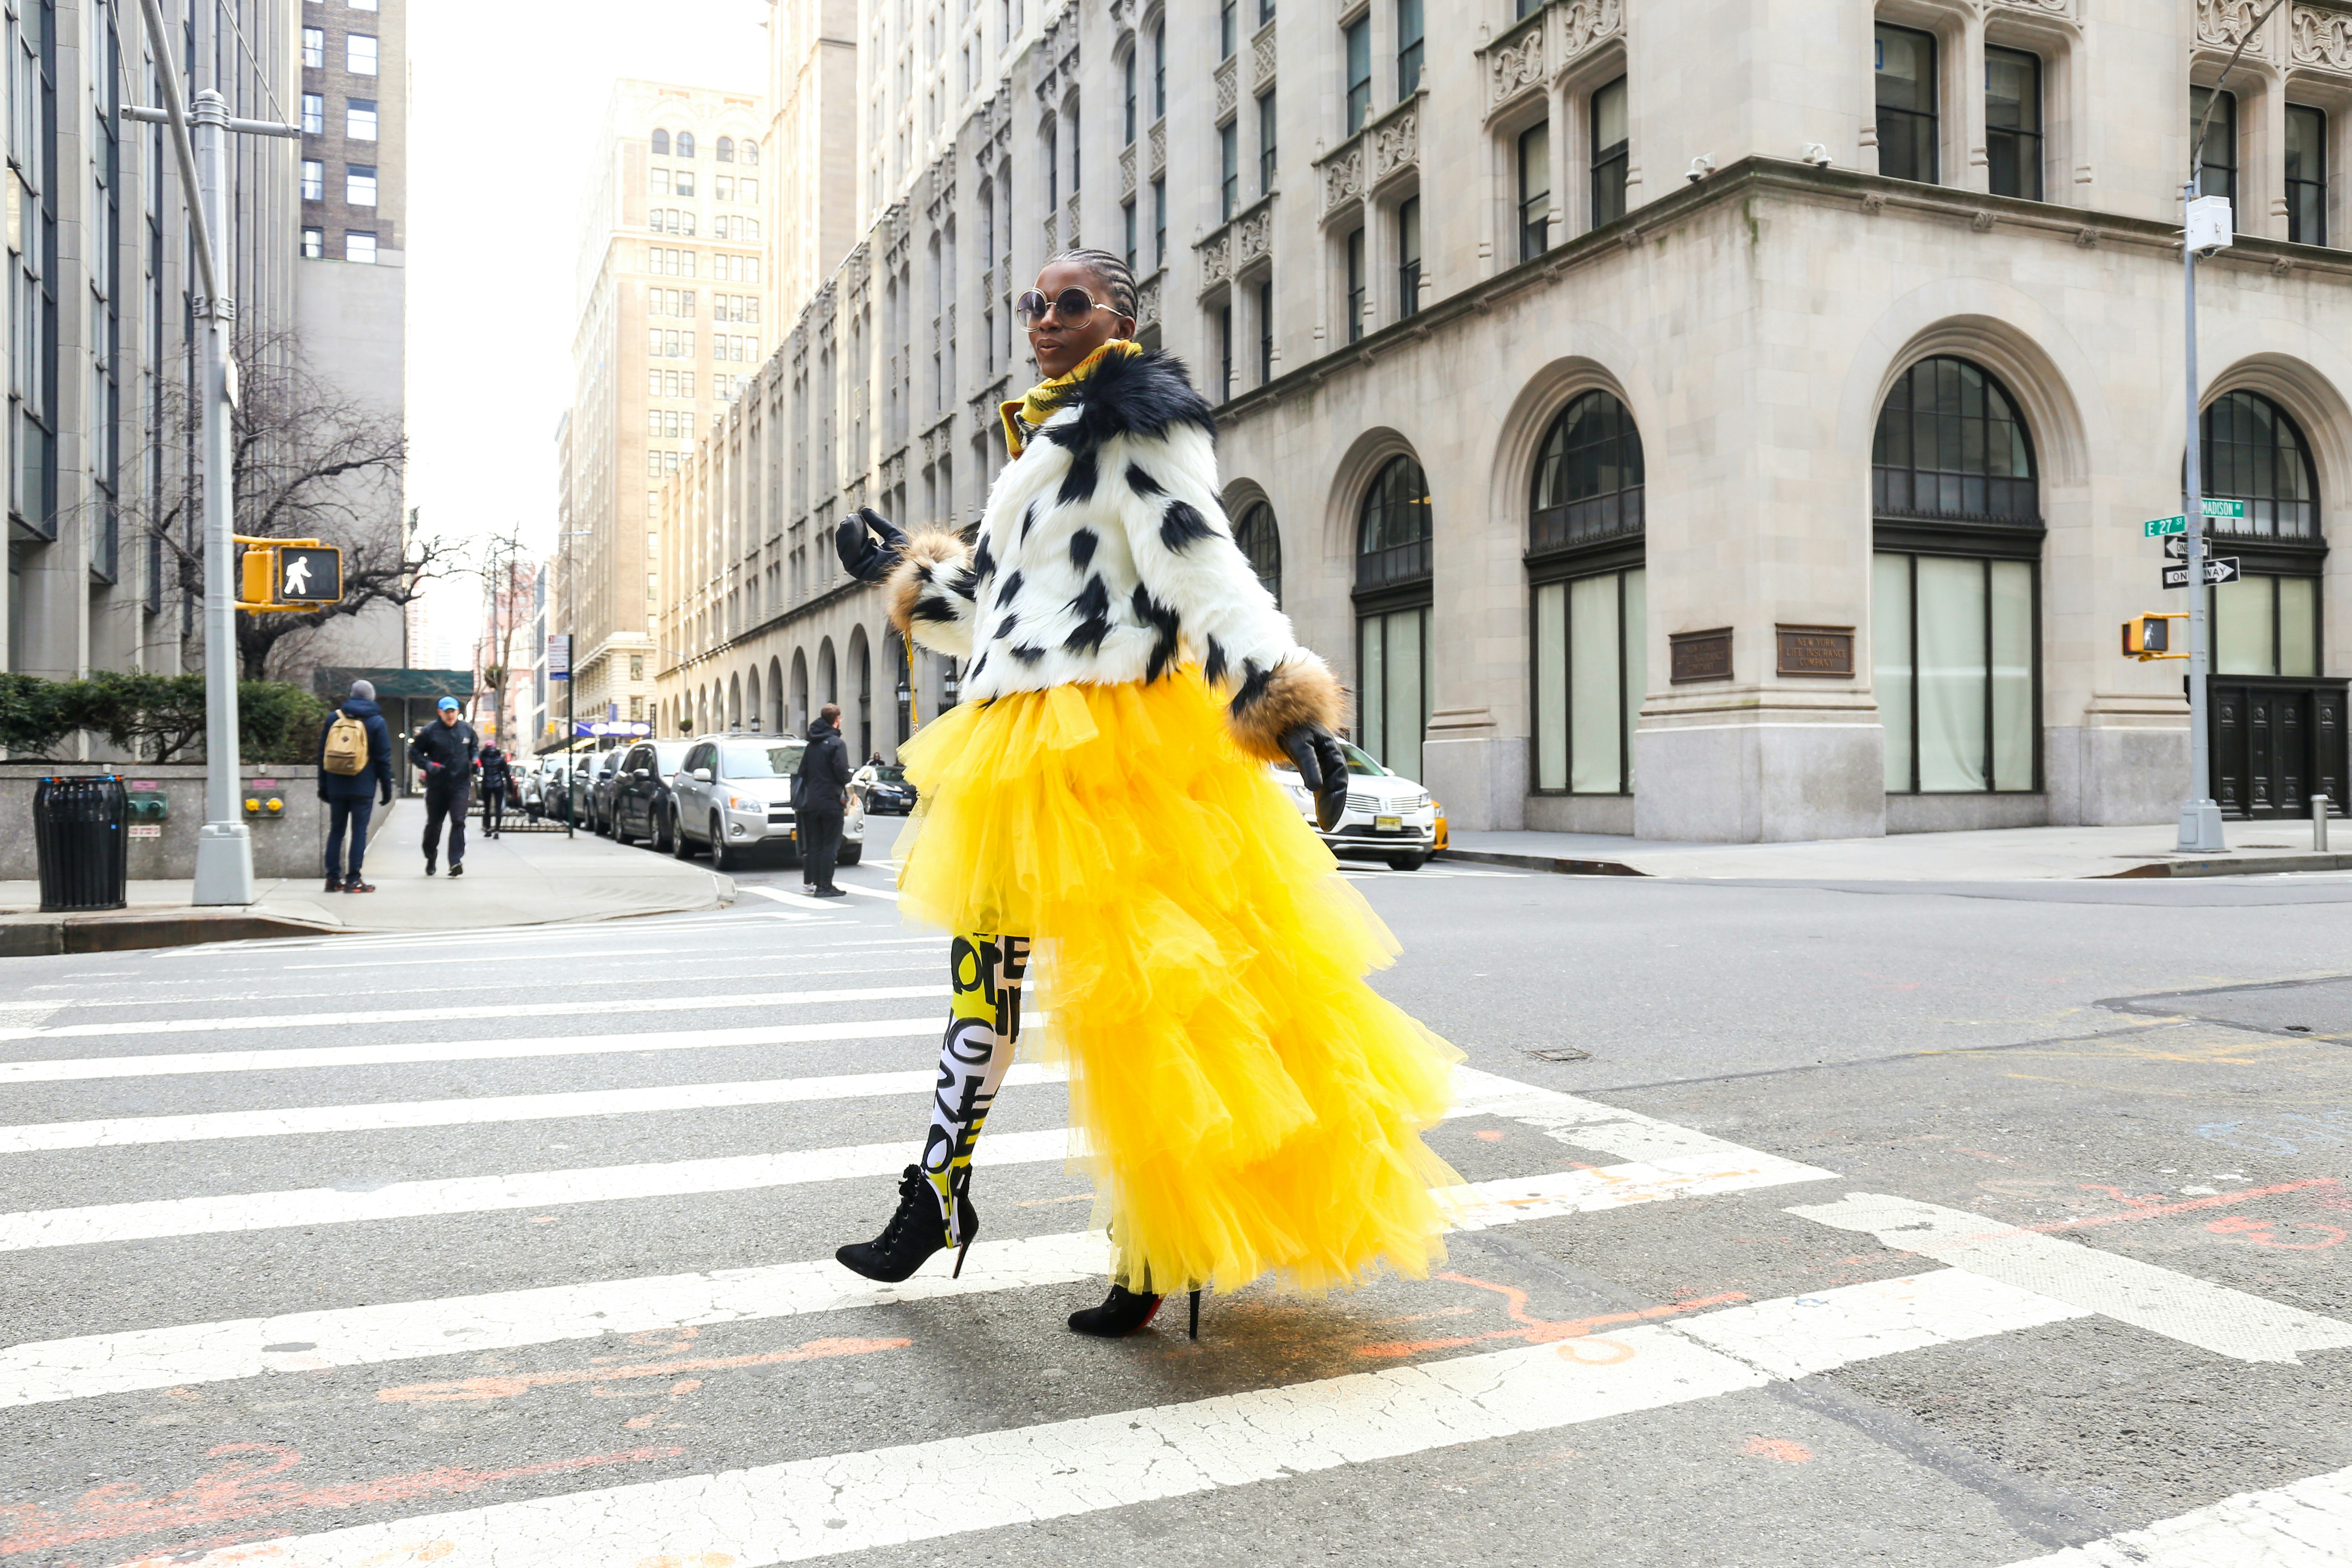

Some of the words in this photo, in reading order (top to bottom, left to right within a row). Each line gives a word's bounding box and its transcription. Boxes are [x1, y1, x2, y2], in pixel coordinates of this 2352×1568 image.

[2203, 502, 2233, 516] MADISON
[2148, 522, 2155, 536] E
[2159, 519, 2172, 534] 27
[2173, 571, 2188, 582] ON
[1798, 638, 1813, 646] NEW
[1816, 639, 1835, 647] YORK
[1786, 648, 1802, 656] LIFE
[1807, 649, 1847, 658] INSURANCE
[1800, 658, 1832, 667] COMPANY
